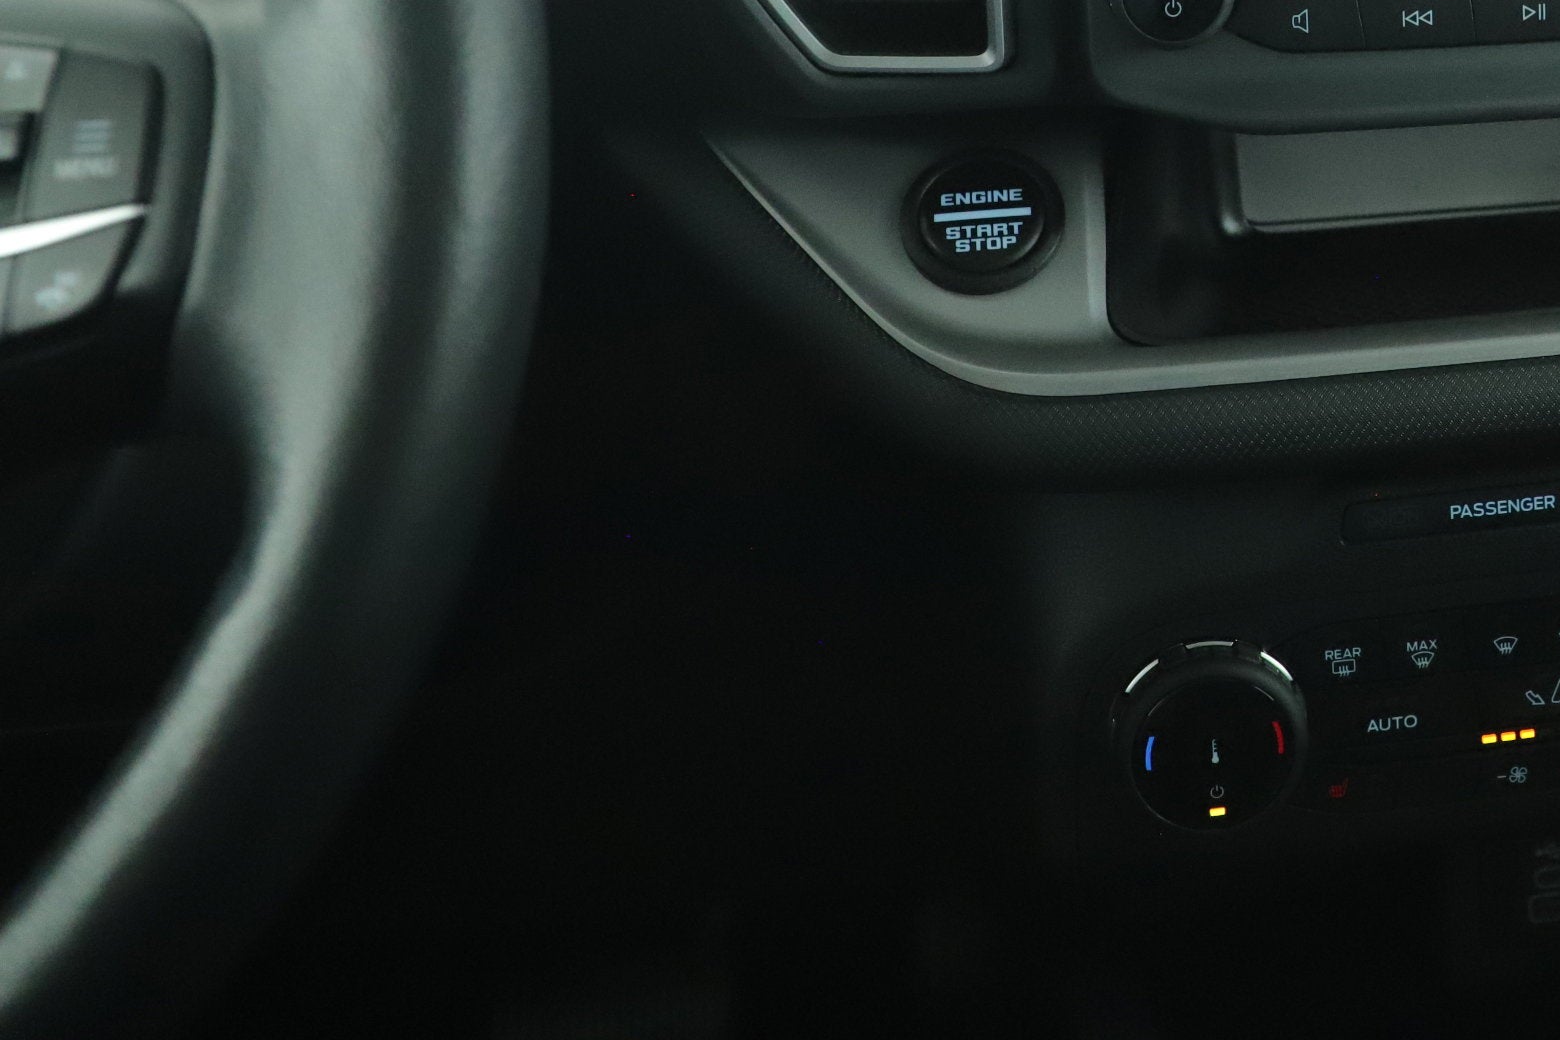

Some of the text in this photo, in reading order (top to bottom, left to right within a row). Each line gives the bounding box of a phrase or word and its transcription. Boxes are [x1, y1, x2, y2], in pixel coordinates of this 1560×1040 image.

[940, 188, 1024, 207] ENGINE
[945, 221, 1024, 240] START
[955, 235, 1017, 253] STOP
[1449, 494, 1556, 520] PASSENGER
[1324, 647, 1362, 661] REAR
[1406, 639, 1438, 652] MAX
[1367, 714, 1418, 733] AUTO
